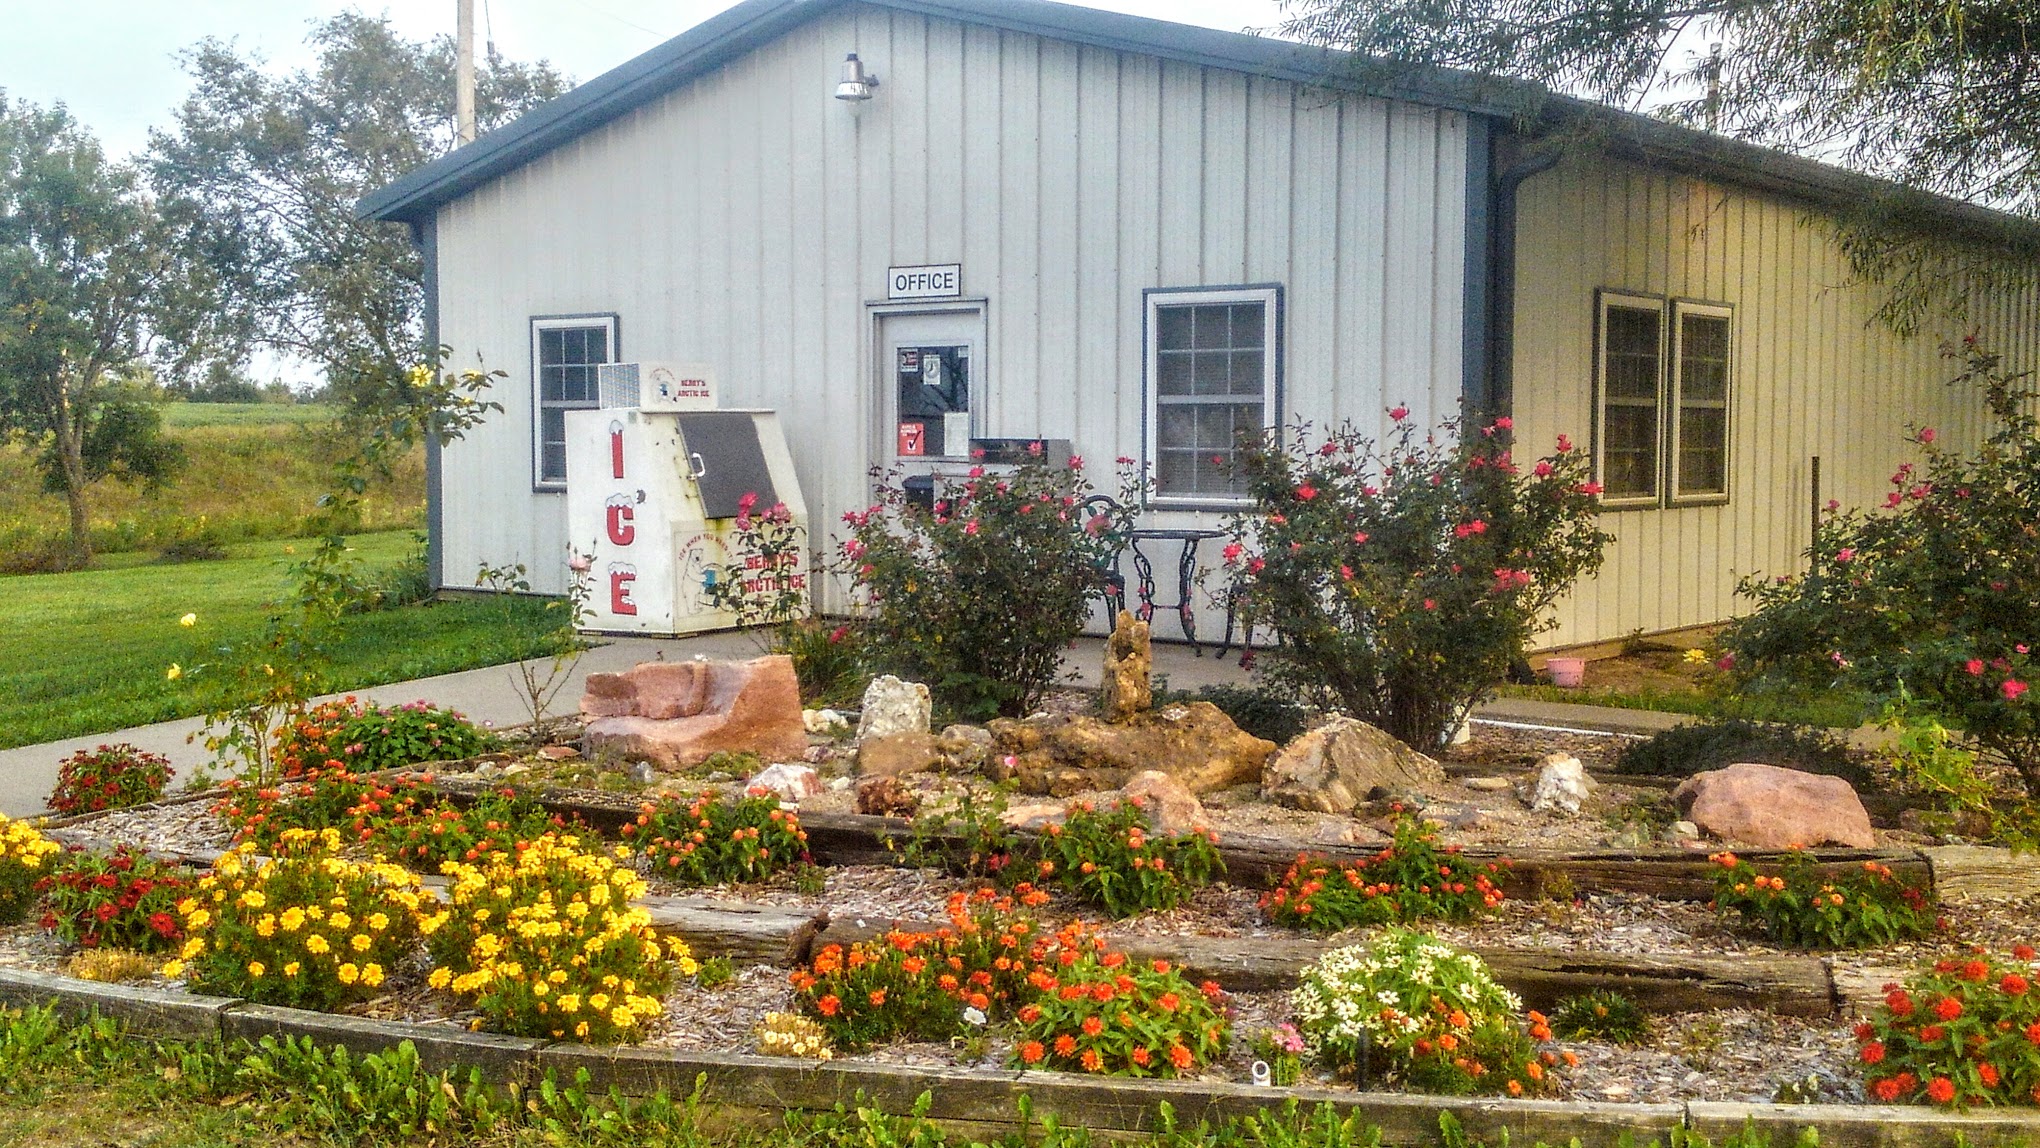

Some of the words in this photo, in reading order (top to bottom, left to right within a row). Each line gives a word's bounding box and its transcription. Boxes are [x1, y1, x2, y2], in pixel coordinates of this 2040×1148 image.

[895, 272, 954, 291] OFFICE
[605, 419, 637, 616] ICE
[686, 534, 702, 548] WHEN
[745, 552, 799, 570] BERY'S
[741, 575, 783, 593] RCTI
